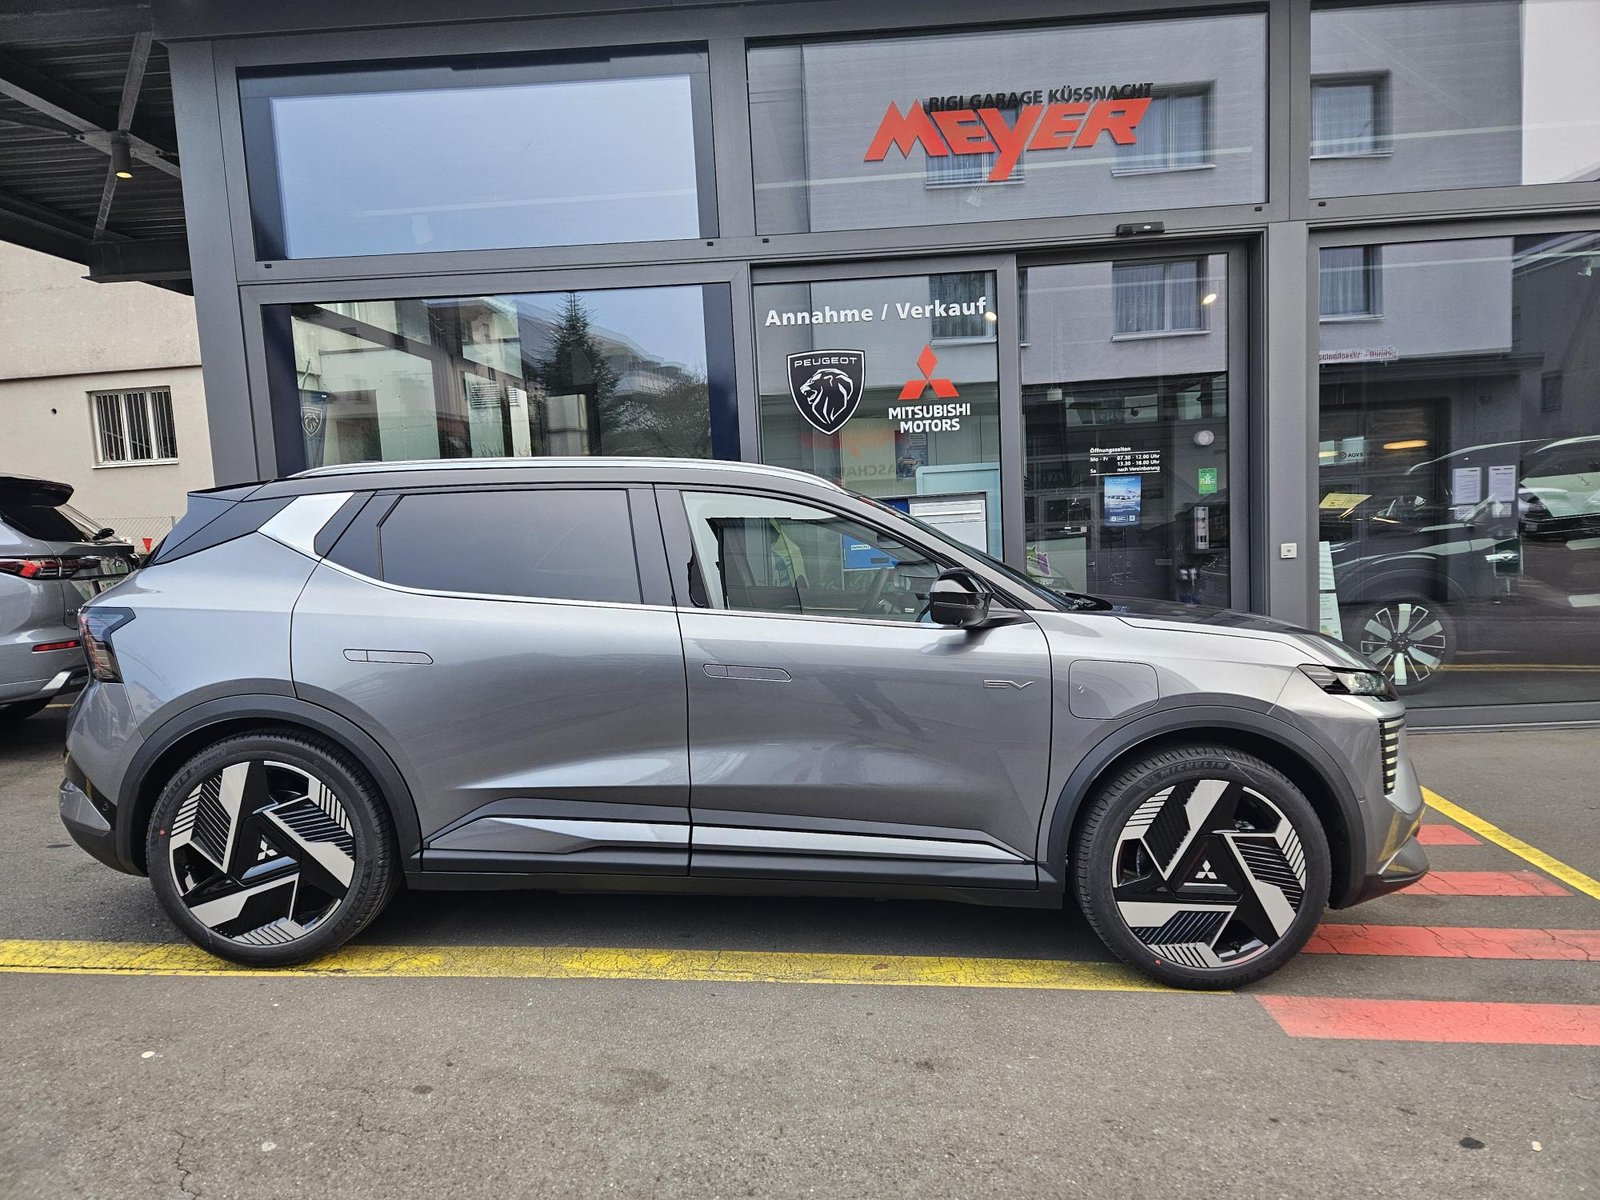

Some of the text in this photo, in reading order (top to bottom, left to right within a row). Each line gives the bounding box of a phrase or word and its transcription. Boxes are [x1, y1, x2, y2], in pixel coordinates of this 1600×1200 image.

[928, 82, 1154, 113] RIGI GARAGE KÜSSNACHT
[863, 97, 1153, 182] MEYER
[766, 296, 986, 327] Annahme / Verkauf
[794, 356, 858, 368] PEUGEOT
[888, 403, 970, 420] MITSUBISHI
[900, 418, 960, 434] MOTORS
[983, 679, 1034, 690] EV
[1158, 761, 1226, 777] MICHELIN
